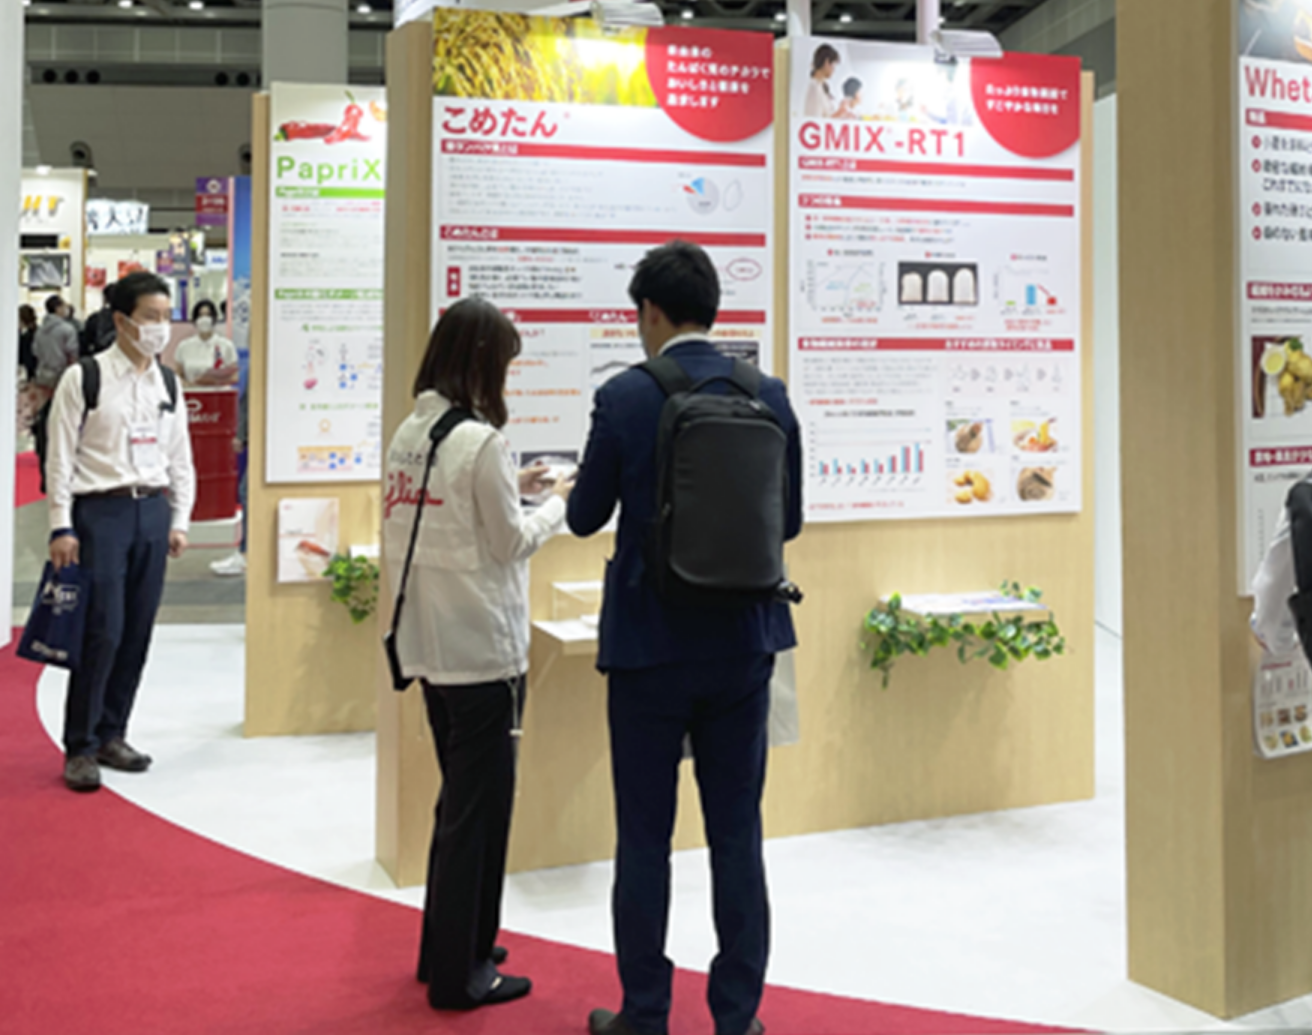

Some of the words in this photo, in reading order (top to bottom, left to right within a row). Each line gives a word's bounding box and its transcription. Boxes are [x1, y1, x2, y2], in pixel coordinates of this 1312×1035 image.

[442, 106, 558, 138] こめたん
[276, 156, 382, 184] PapriX
